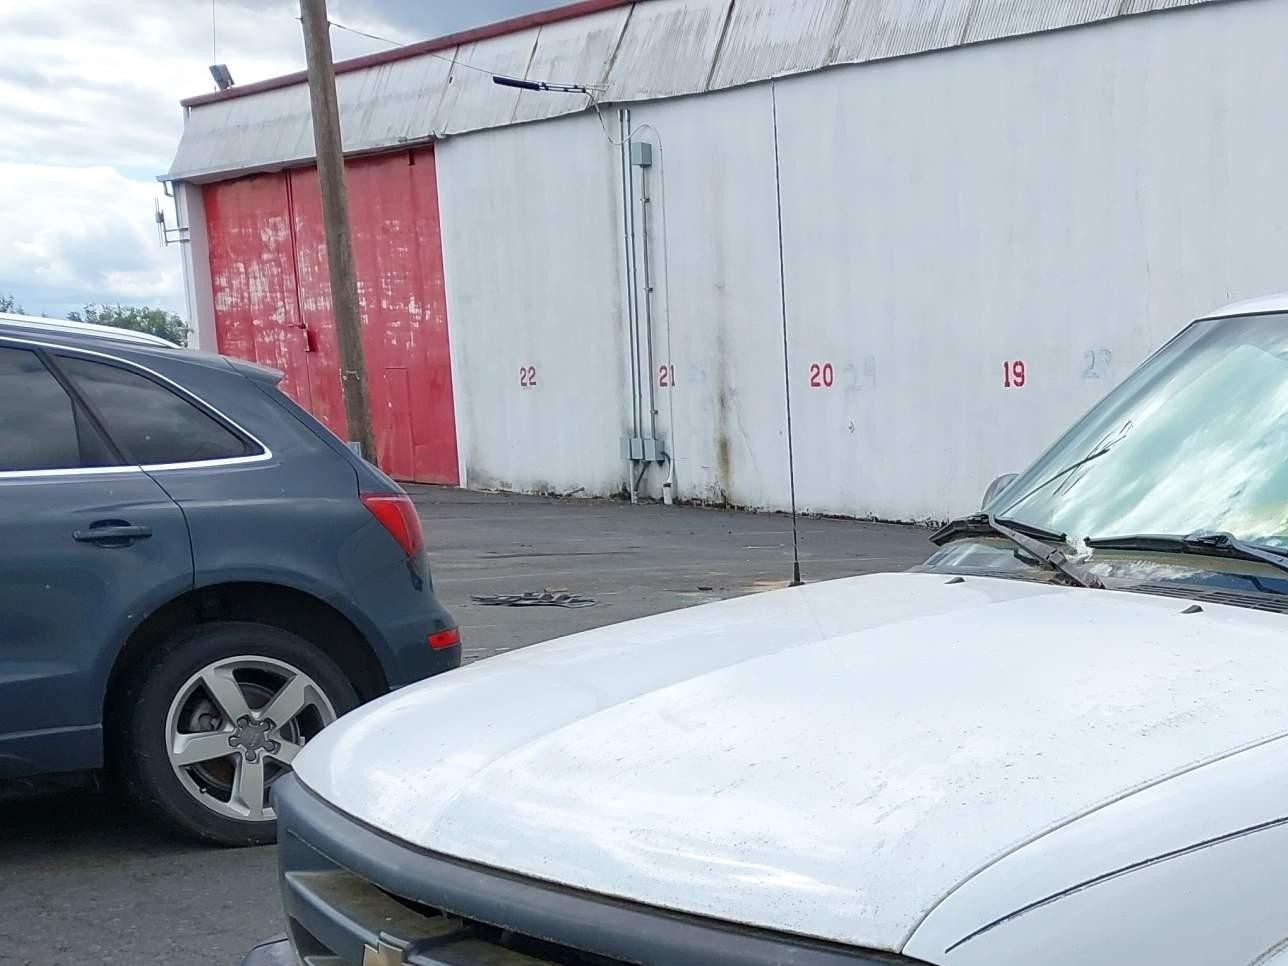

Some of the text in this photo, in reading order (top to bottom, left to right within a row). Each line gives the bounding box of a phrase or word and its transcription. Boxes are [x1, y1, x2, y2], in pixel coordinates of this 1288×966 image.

[520, 366, 536, 387] 22
[659, 365, 675, 387] 21
[810, 363, 833, 387] 20
[1003, 361, 1025, 387] 19
